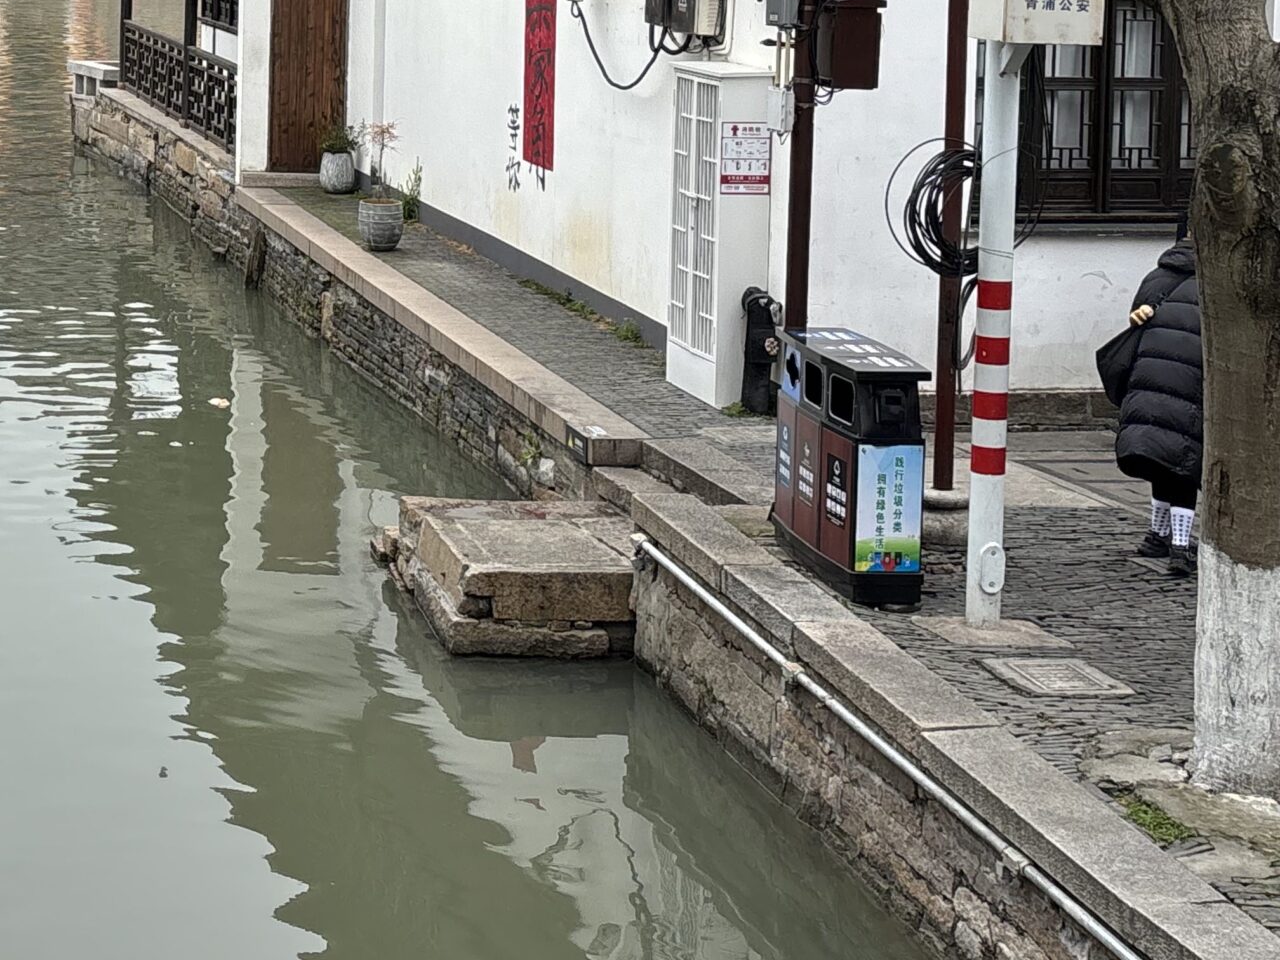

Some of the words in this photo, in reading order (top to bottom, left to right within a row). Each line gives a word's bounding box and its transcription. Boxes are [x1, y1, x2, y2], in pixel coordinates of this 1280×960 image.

[875, 473, 887, 550] 拥有绿色生活
[892, 456, 905, 533] 践行垃圾分类
